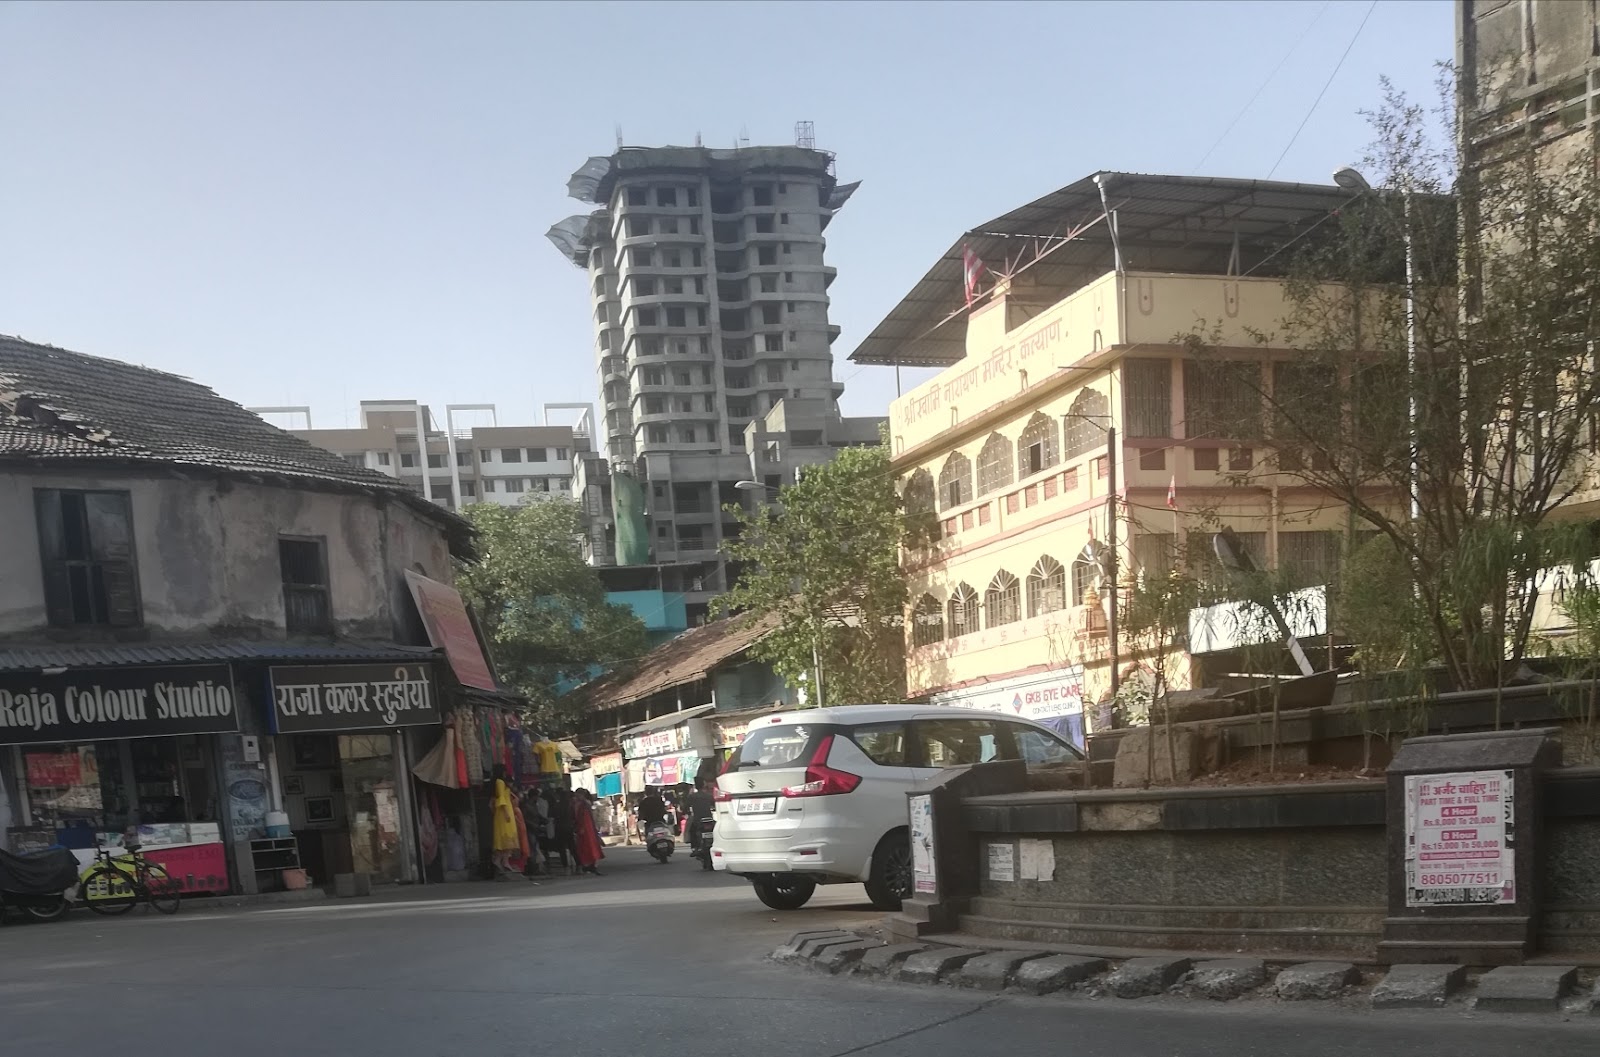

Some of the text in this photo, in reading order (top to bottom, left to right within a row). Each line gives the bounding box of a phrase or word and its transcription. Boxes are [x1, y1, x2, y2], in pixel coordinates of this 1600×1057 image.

[944, 366, 980, 403] नारायण
[276, 684, 322, 716] राजा
[323, 682, 370, 714] कलर
[1025, 683, 1083, 704] GKB EYE CARE
[0, 680, 232, 731] Raja Colour Studio
[1459, 781, 1486, 795] चाहिए
[1420, 798, 1437, 806] PART
[1439, 797, 1455, 805] TIME
[1464, 796, 1480, 804] FULL
[1481, 795, 1499, 803] TIME
[1452, 807, 1475, 815] Hour
[1452, 831, 1475, 839] Hour
[1421, 873, 1498, 885] 8805077511
